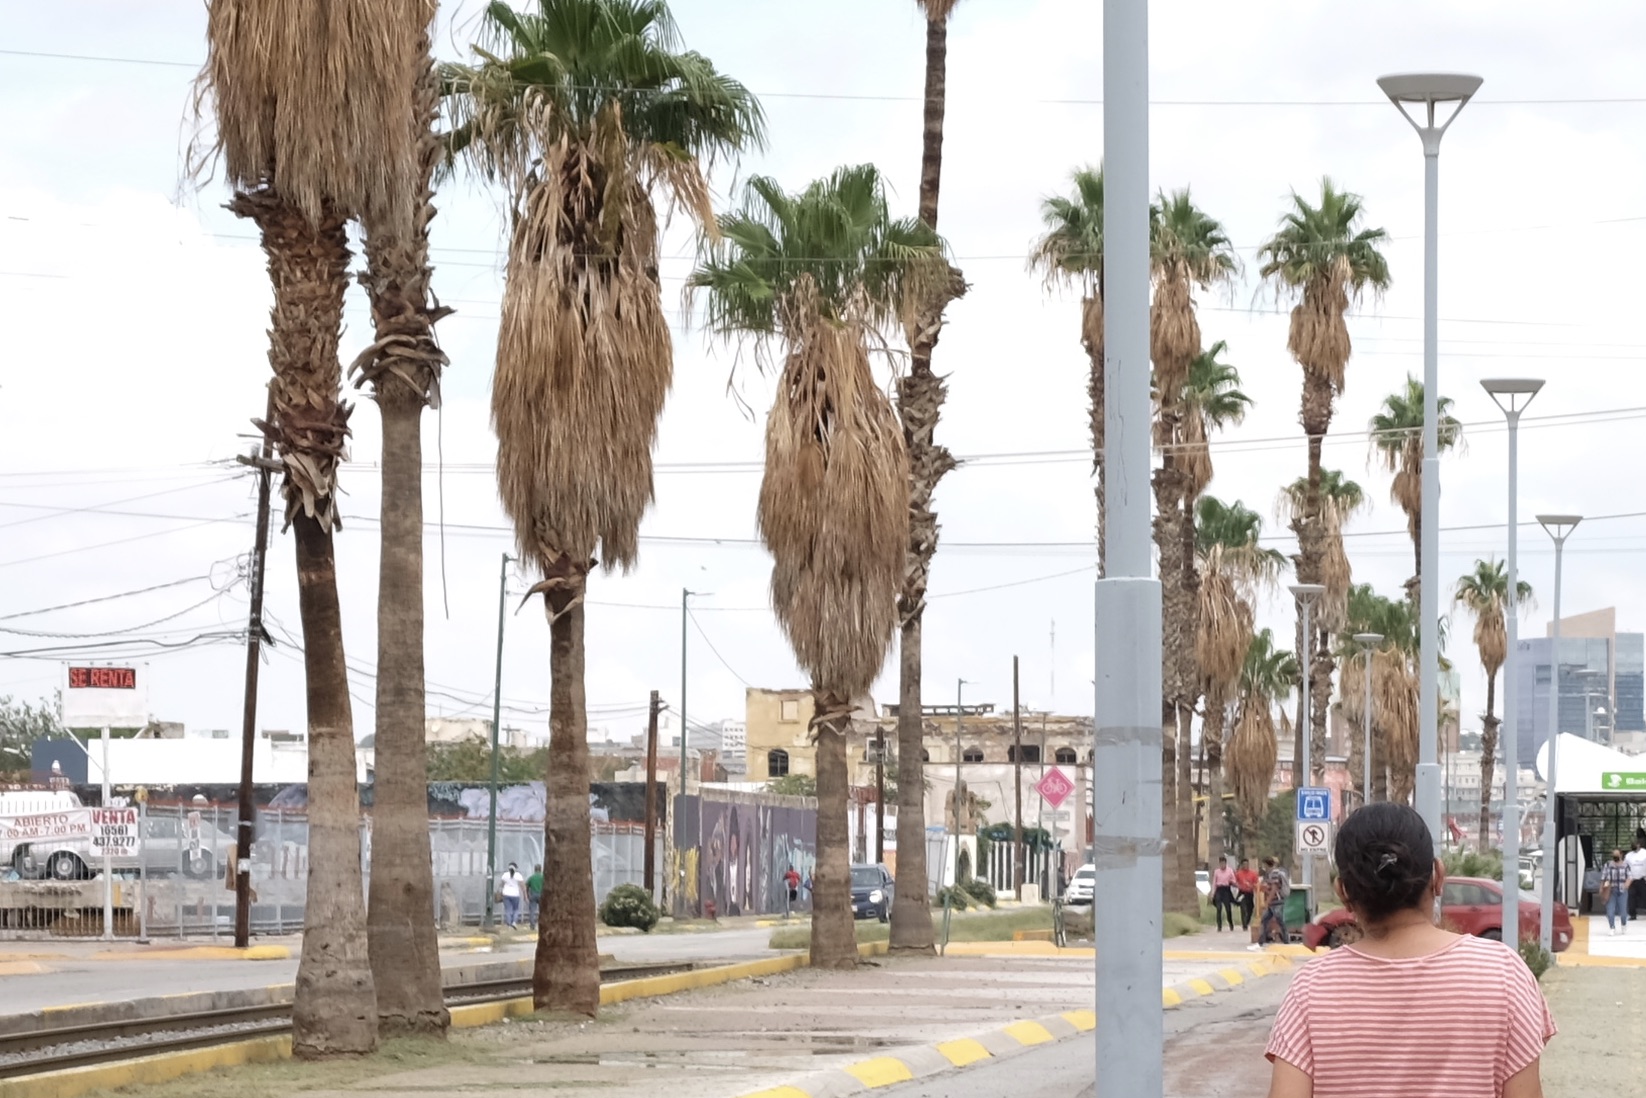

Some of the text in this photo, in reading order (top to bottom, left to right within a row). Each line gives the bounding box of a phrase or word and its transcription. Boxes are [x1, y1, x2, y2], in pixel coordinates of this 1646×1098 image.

[71, 668, 135, 688] SE RENTA
[14, 814, 69, 828] ABIERTO
[92, 809, 136, 825] VENTA
